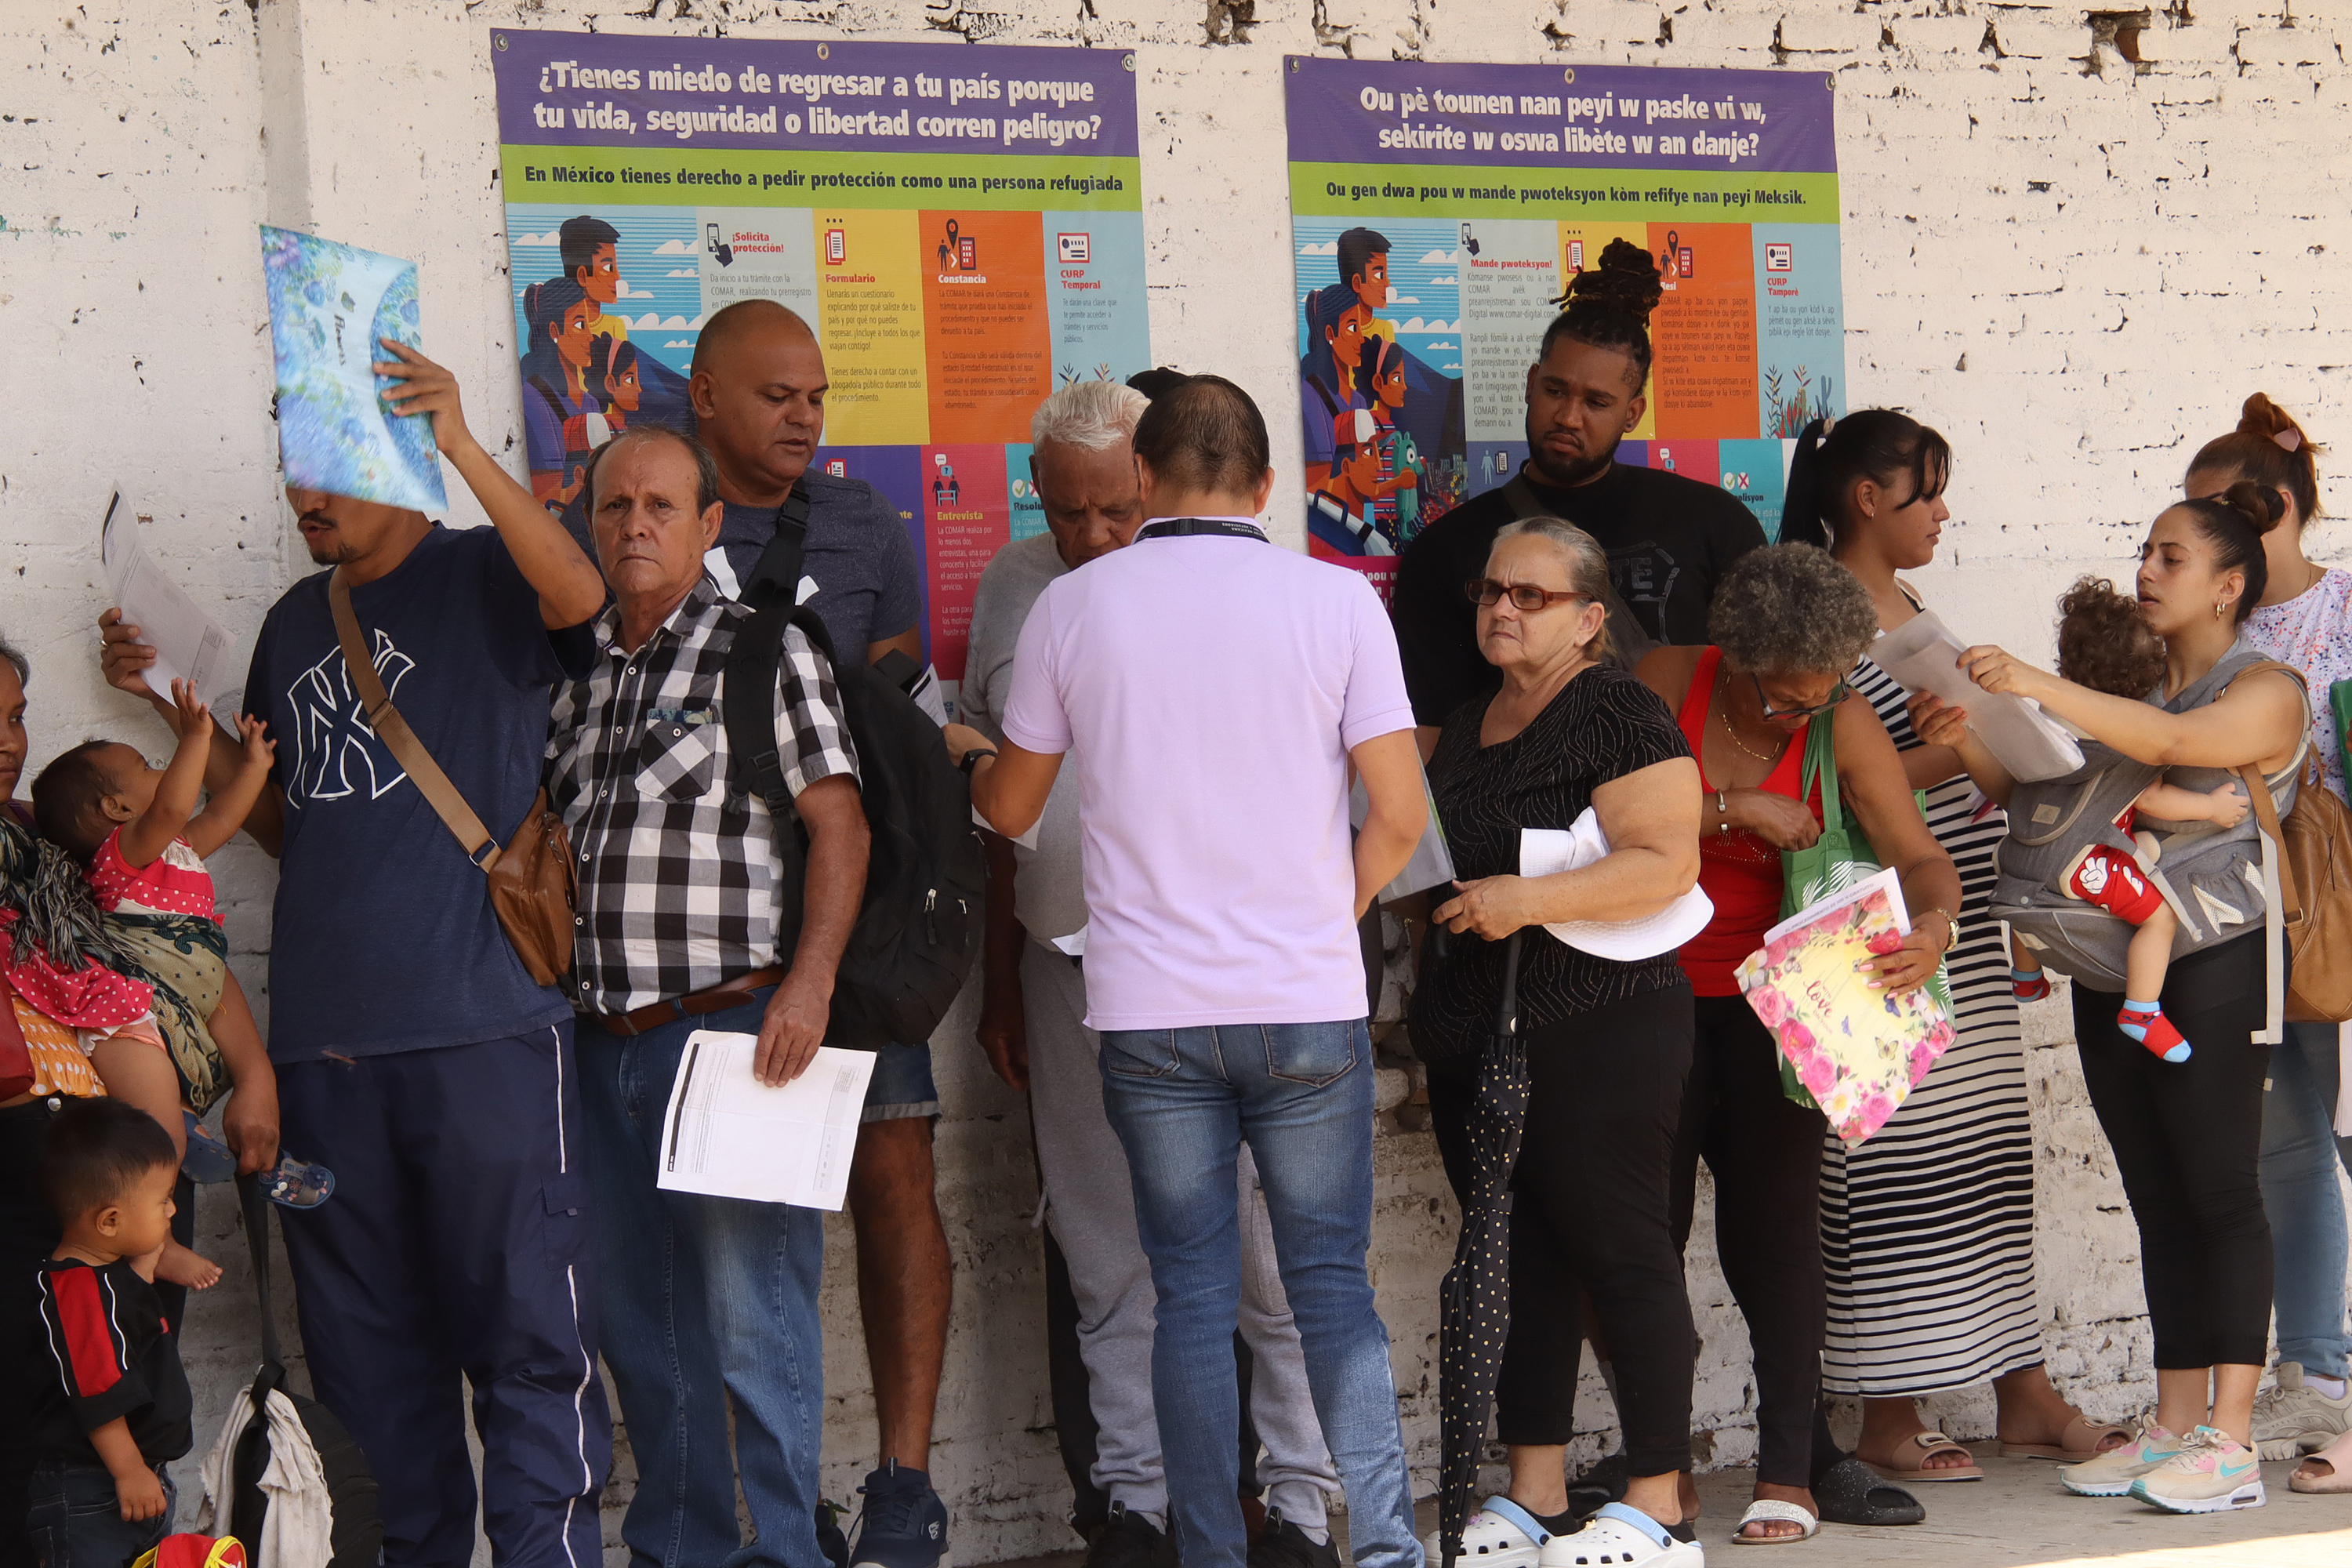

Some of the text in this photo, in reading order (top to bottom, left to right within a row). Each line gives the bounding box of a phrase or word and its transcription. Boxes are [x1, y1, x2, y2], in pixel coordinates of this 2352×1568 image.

[539, 60, 1094, 108] ¿Tienes miedo de regresar a tu país porque
[1360, 86, 1766, 125] Ou pè tounen nan peyi w paske vi w,
[534, 101, 1102, 147] tu vida, seguridad o libertad corren peligro?
[1378, 122, 1759, 163] sekirite w oswa libète w an danje?
[525, 165, 1123, 194] En México tienes derecho a pedir protección como una persona refugiada
[1327, 181, 1806, 207] Ou gen dwa pou w mande pwoteksyon kòm refifye nan peyi Meksik.
[732, 232, 770, 243] ¡Solicita
[733, 243, 784, 254] protección!
[1471, 259, 1552, 270] Mande pwoteksyon!
[826, 274, 876, 282] Formulario
[938, 274, 986, 283] Constancia
[1060, 270, 1085, 278] CURP
[1467, 273, 1493, 281] Kòmanse
[1497, 274, 1523, 283] pwosesis
[1061, 280, 1101, 291] Temporal
[1767, 278, 1788, 286] CURP
[710, 287, 735, 297] COMAR,
[739, 287, 769, 296] realizando
[779, 287, 811, 298] prerregistro
[826, 289, 850, 298] Llenarás
[1468, 285, 1558, 296] COMAR avèk yon
[1767, 288, 1799, 298] Tamporè
[827, 303, 858, 312] explicando
[870, 303, 881, 312] qué
[882, 303, 900, 311] saliste
[902, 303, 909, 311] de
[1469, 309, 1488, 320] Digital
[1473, 406, 1497, 416] COMAR)
[1502, 408, 1513, 417] pou
[937, 511, 983, 521] Entrevista
